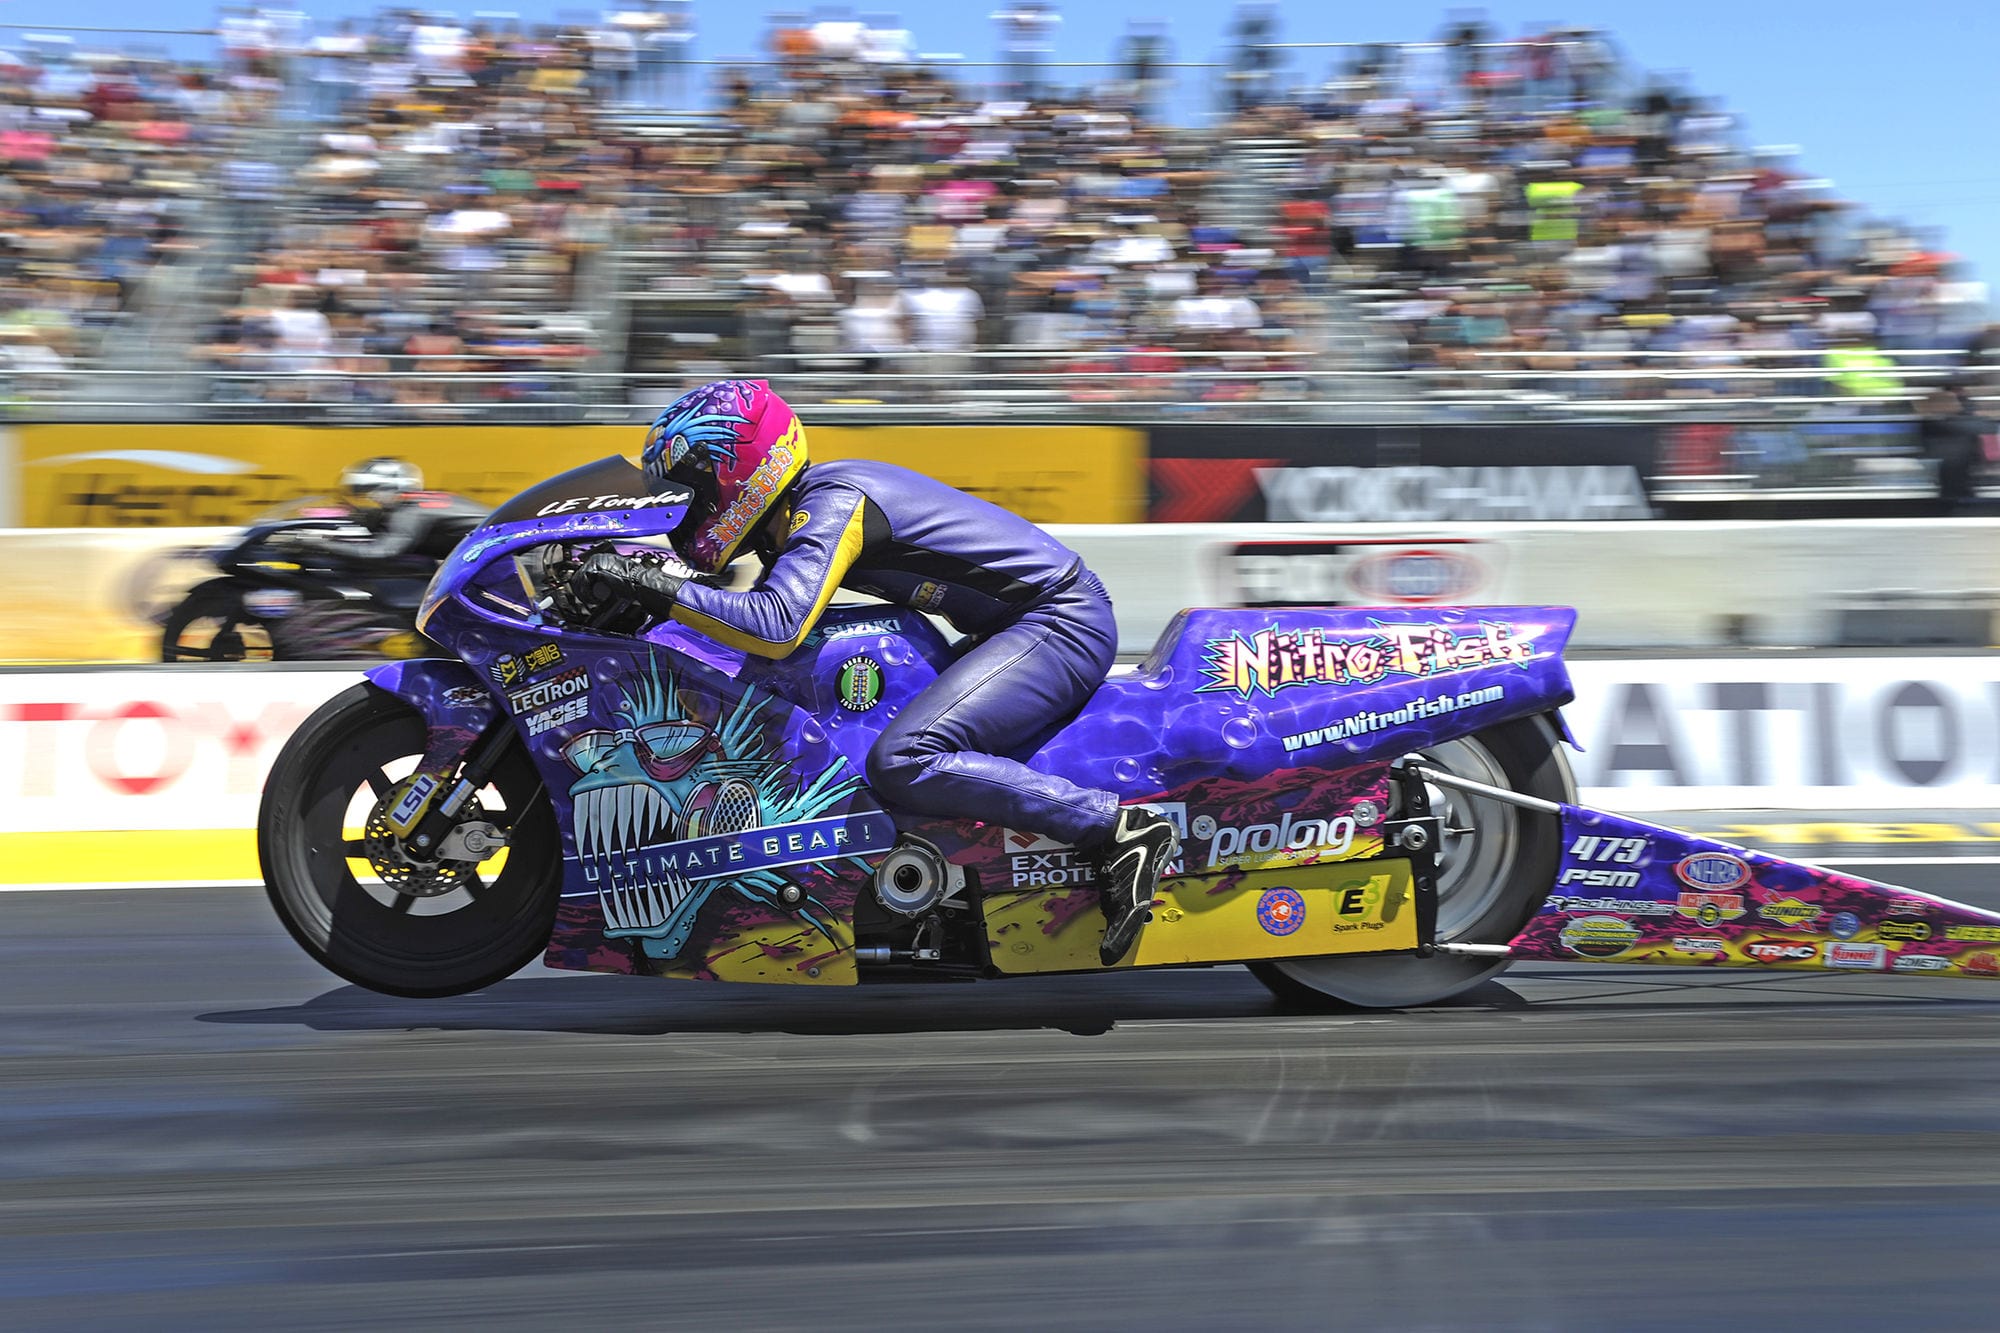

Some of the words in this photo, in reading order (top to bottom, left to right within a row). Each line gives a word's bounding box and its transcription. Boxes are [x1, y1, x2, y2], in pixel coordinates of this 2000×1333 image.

[823, 619, 901, 639] SUZUKI
[511, 674, 589, 715] LECTRON
[525, 696, 588, 727] VANCE
[529, 707, 589, 736] HINES
[1282, 684, 1504, 752] www.NitroFish.com
[391, 775, 436, 825] LSU
[1207, 813, 1356, 867] prolong
[1569, 835, 1648, 863] 473
[584, 844, 744, 882] ULTIMATE
[1687, 860, 1741, 884] NHRA
[1559, 869, 1641, 888] PSM
[1766, 906, 1818, 918] SUNOCO
[1333, 923, 1358, 933] Spark
[1361, 921, 1385, 932] Plugs
[1748, 944, 1816, 957] TRAC
